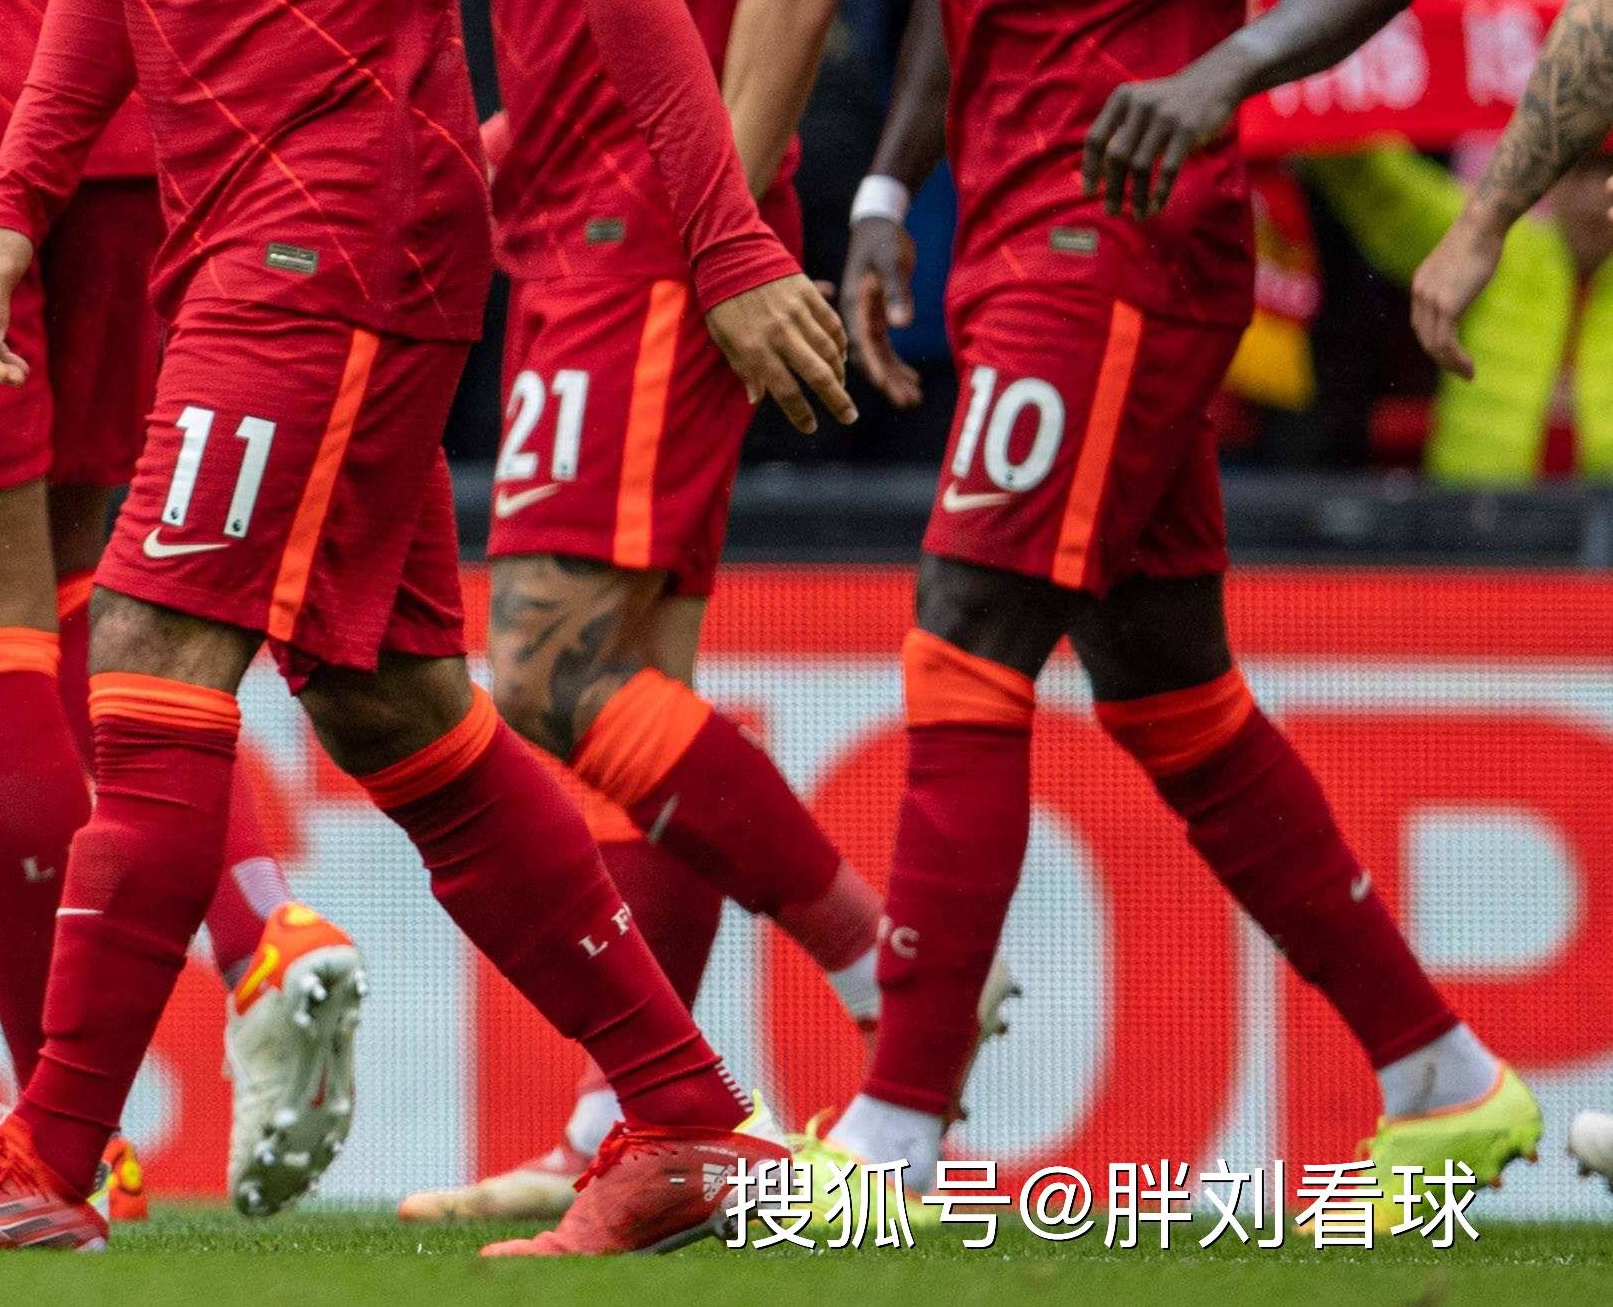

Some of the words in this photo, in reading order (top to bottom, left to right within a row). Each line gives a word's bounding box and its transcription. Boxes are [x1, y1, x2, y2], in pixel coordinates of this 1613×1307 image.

[160, 404, 277, 539] 11
[493, 368, 590, 483] 21
[951, 364, 1066, 493] 10
